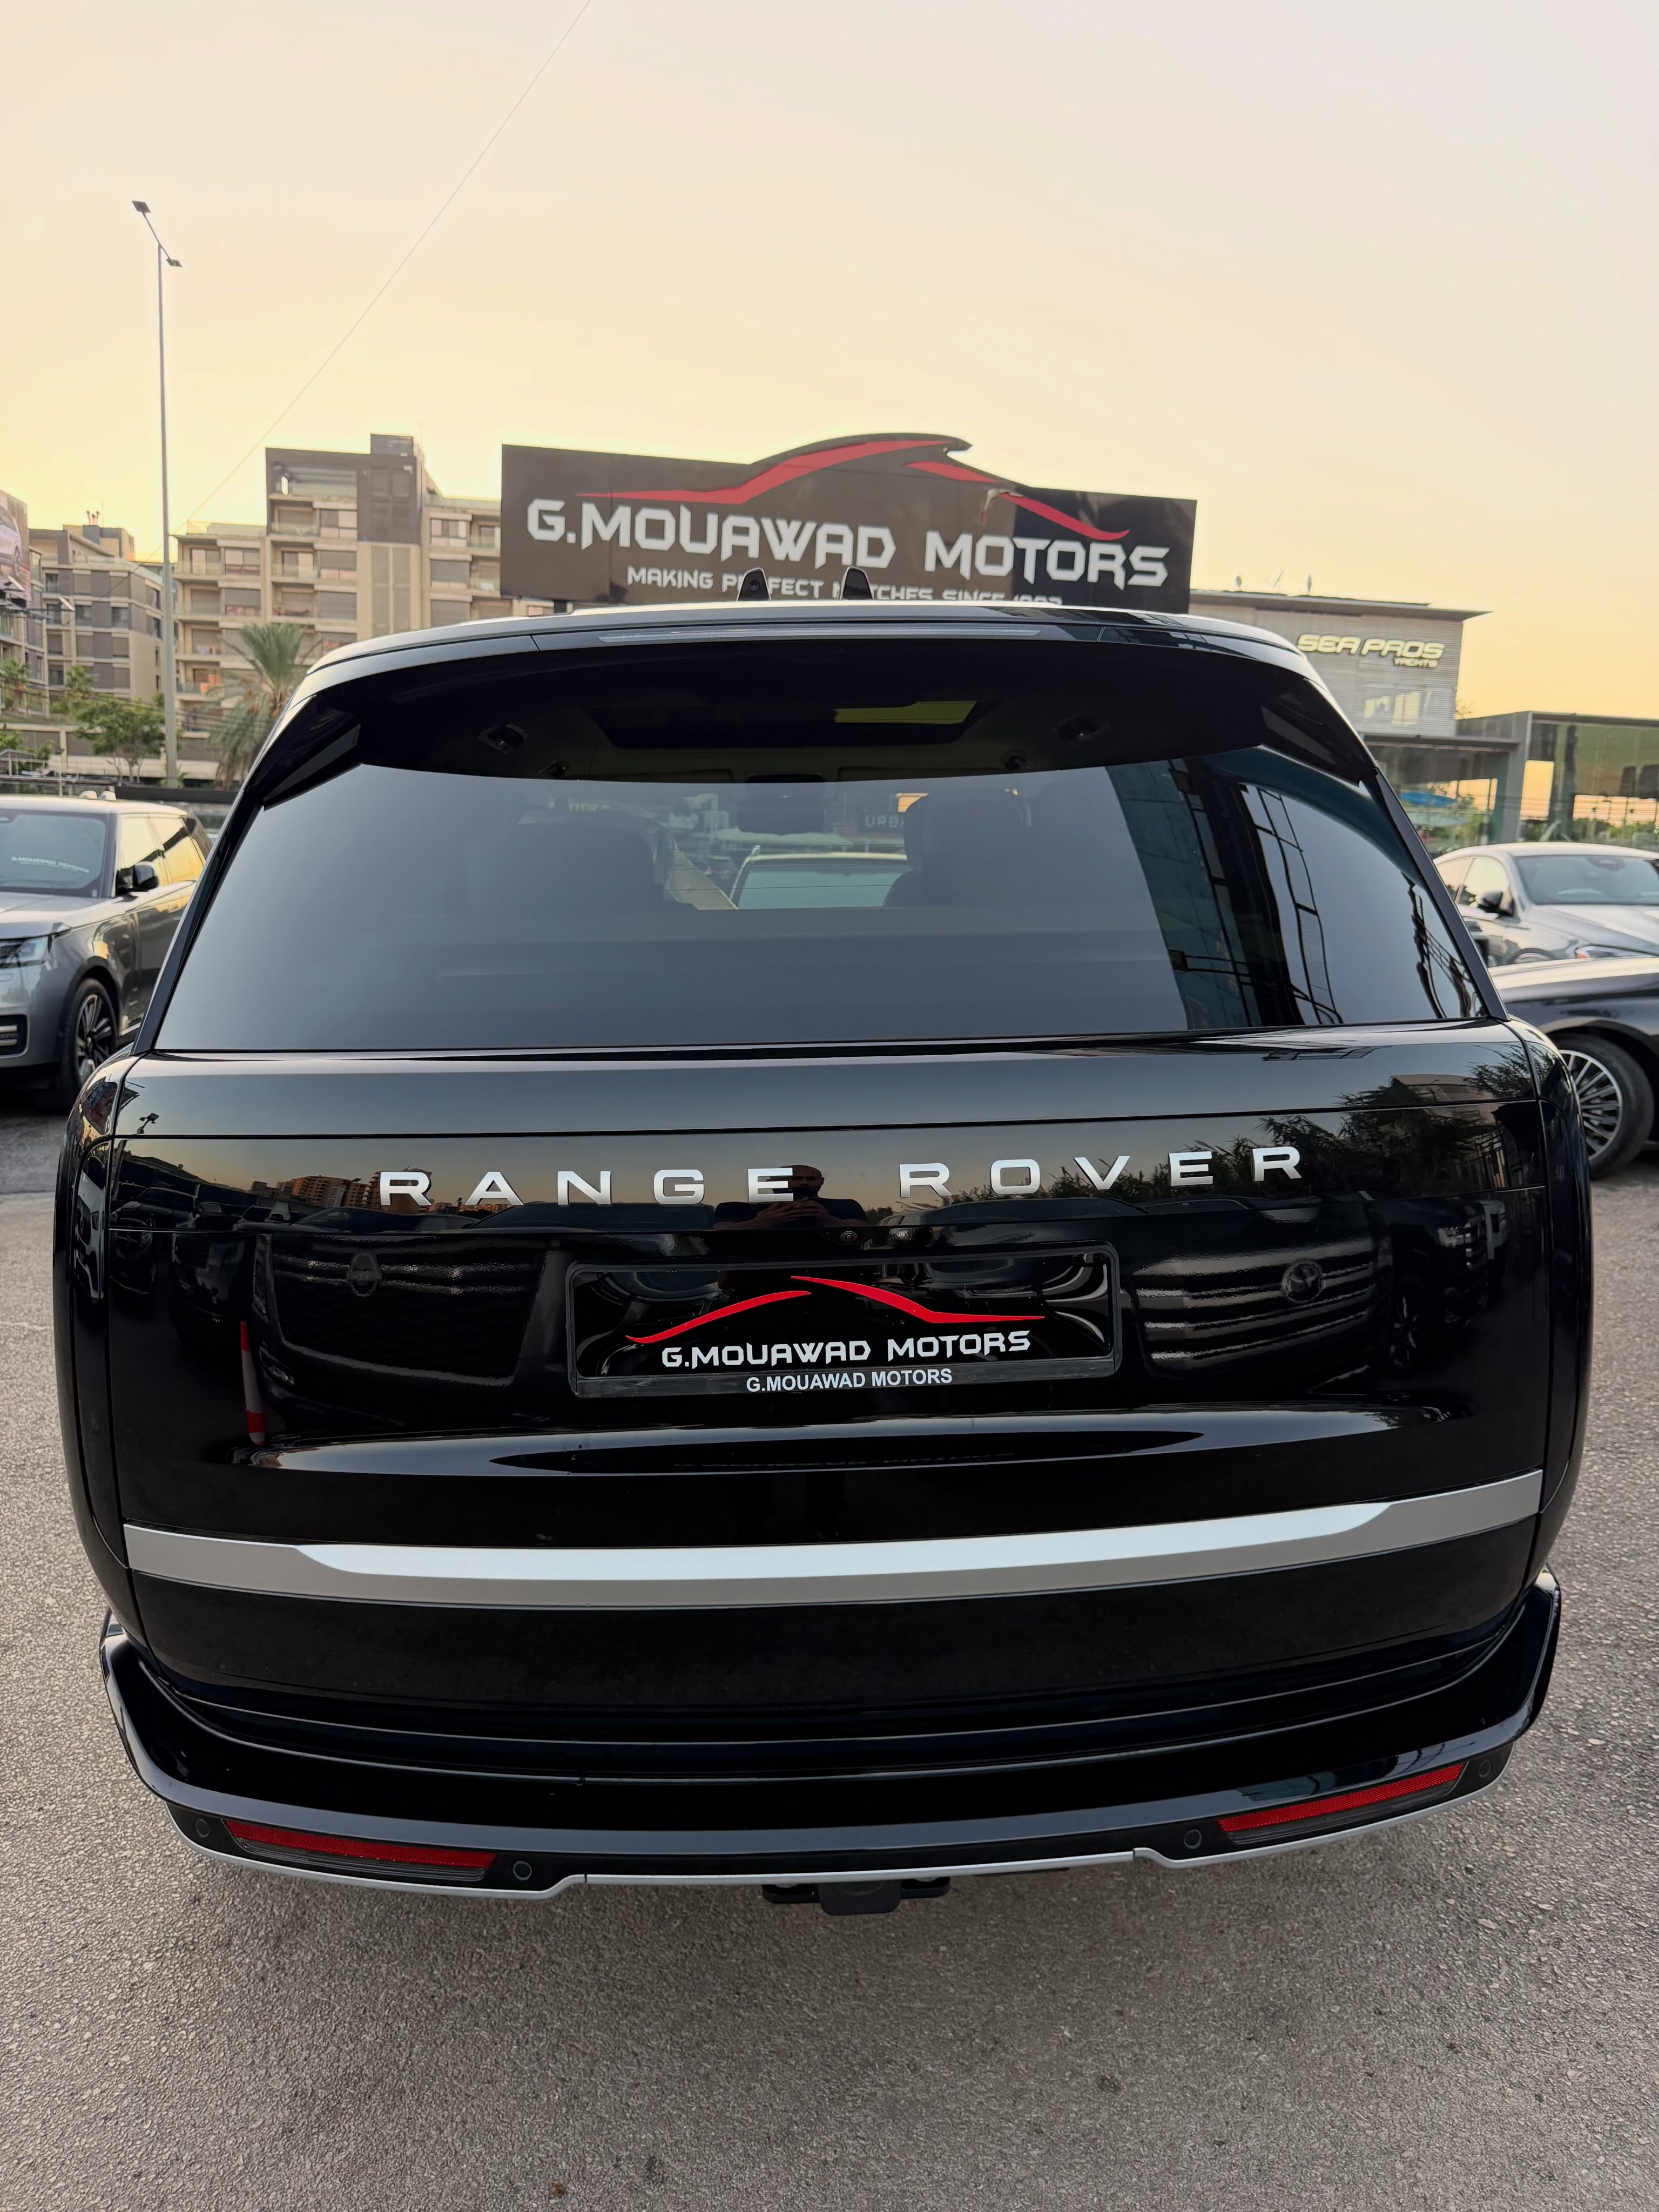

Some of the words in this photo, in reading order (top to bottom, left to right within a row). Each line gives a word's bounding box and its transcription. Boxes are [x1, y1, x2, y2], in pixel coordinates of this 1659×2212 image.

[527, 498, 896, 569] G.MOUAWAD
[925, 530, 1170, 591] MOTORS
[627, 565, 713, 589] MAKING
[722, 572, 825, 599] PFECT
[1297, 634, 1361, 655] SEA
[380, 1167, 794, 1206] RANGE
[899, 1146, 1302, 1198] ROVER
[662, 1340, 871, 1369] G.MOUAWAD
[887, 1330, 1031, 1361] MOTORS
[746, 1372, 866, 1392] G.MOUAWAD
[872, 1368, 952, 1387] MOTORS
